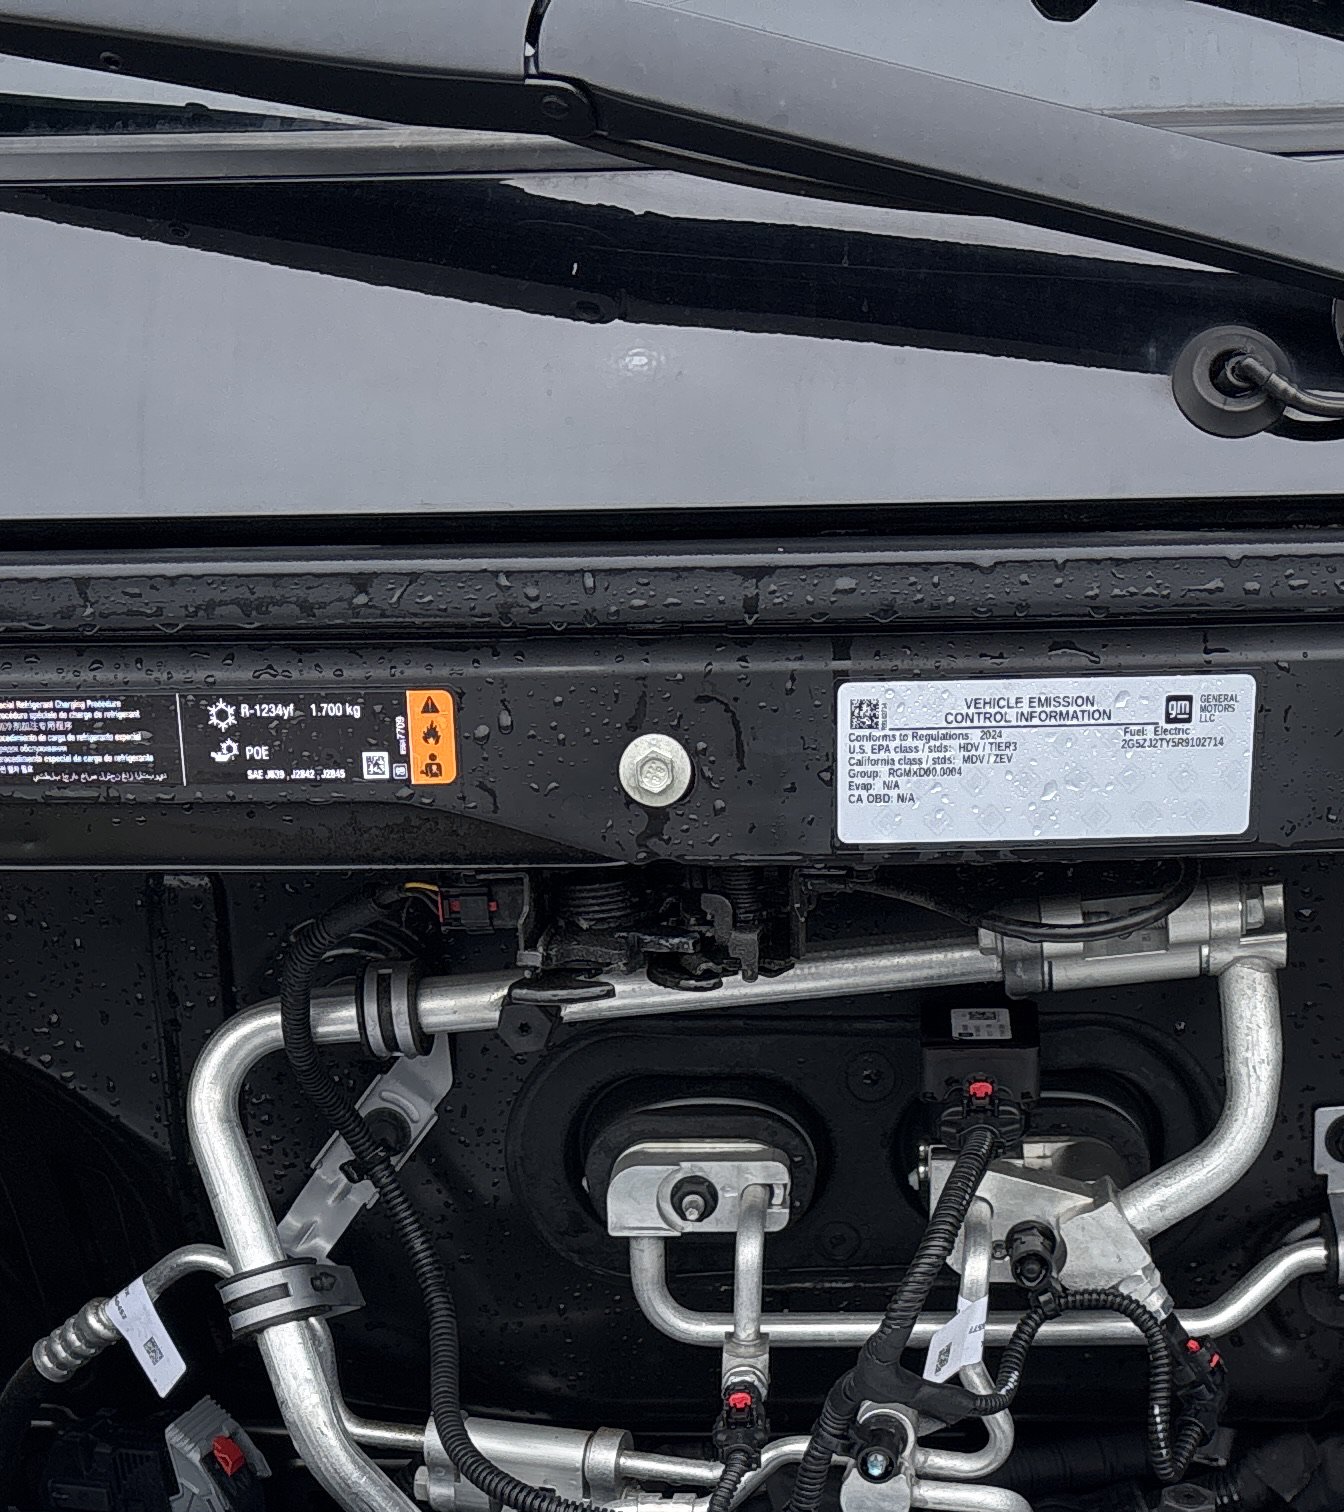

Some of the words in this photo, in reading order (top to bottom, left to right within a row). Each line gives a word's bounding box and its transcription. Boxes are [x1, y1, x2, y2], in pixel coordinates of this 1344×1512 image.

[964, 697, 1024, 710] VEHICLE
[1028, 695, 1096, 709] EMISSION
[1199, 694, 1239, 704] GENERAL
[240, 704, 295, 720] R-1234yf
[310, 703, 343, 717] 1.700
[345, 703, 361, 719] kg
[1168, 700, 1190, 719] gm
[1199, 703, 1236, 714] MOTORS
[944, 711, 1012, 725] CONTROL
[1015, 709, 1112, 723] INFORMATION
[1199, 713, 1216, 724] LLC
[848, 732, 897, 743] Conforms
[898, 733, 909, 742] to
[979, 729, 1003, 741] 2024
[1123, 726, 1148, 737] Fuel:
[1153, 726, 1191, 737] Electric
[870, 744, 892, 755] EPA
[893, 744, 920, 754] class
[927, 743, 952, 754] stds:
[958, 742, 980, 753] HDV
[988, 741, 1018, 752] TIER3
[1121, 737, 1225, 749] 2G5ZJ2TY5R9102714
[245, 746, 270, 760] POE
[847, 756, 896, 767] California
[897, 756, 924, 766] class
[931, 755, 955, 766] stds:
[962, 754, 986, 765] MDV
[993, 753, 1014, 764] ZEV
[246, 769, 264, 780] SAE
[847, 769, 882, 781] Group:
[848, 781, 876, 793] Evap:
[882, 780, 900, 791] N/A
[848, 793, 864, 804] CA
[866, 793, 893, 804] OBD:
[896, 793, 916, 804] N/A
